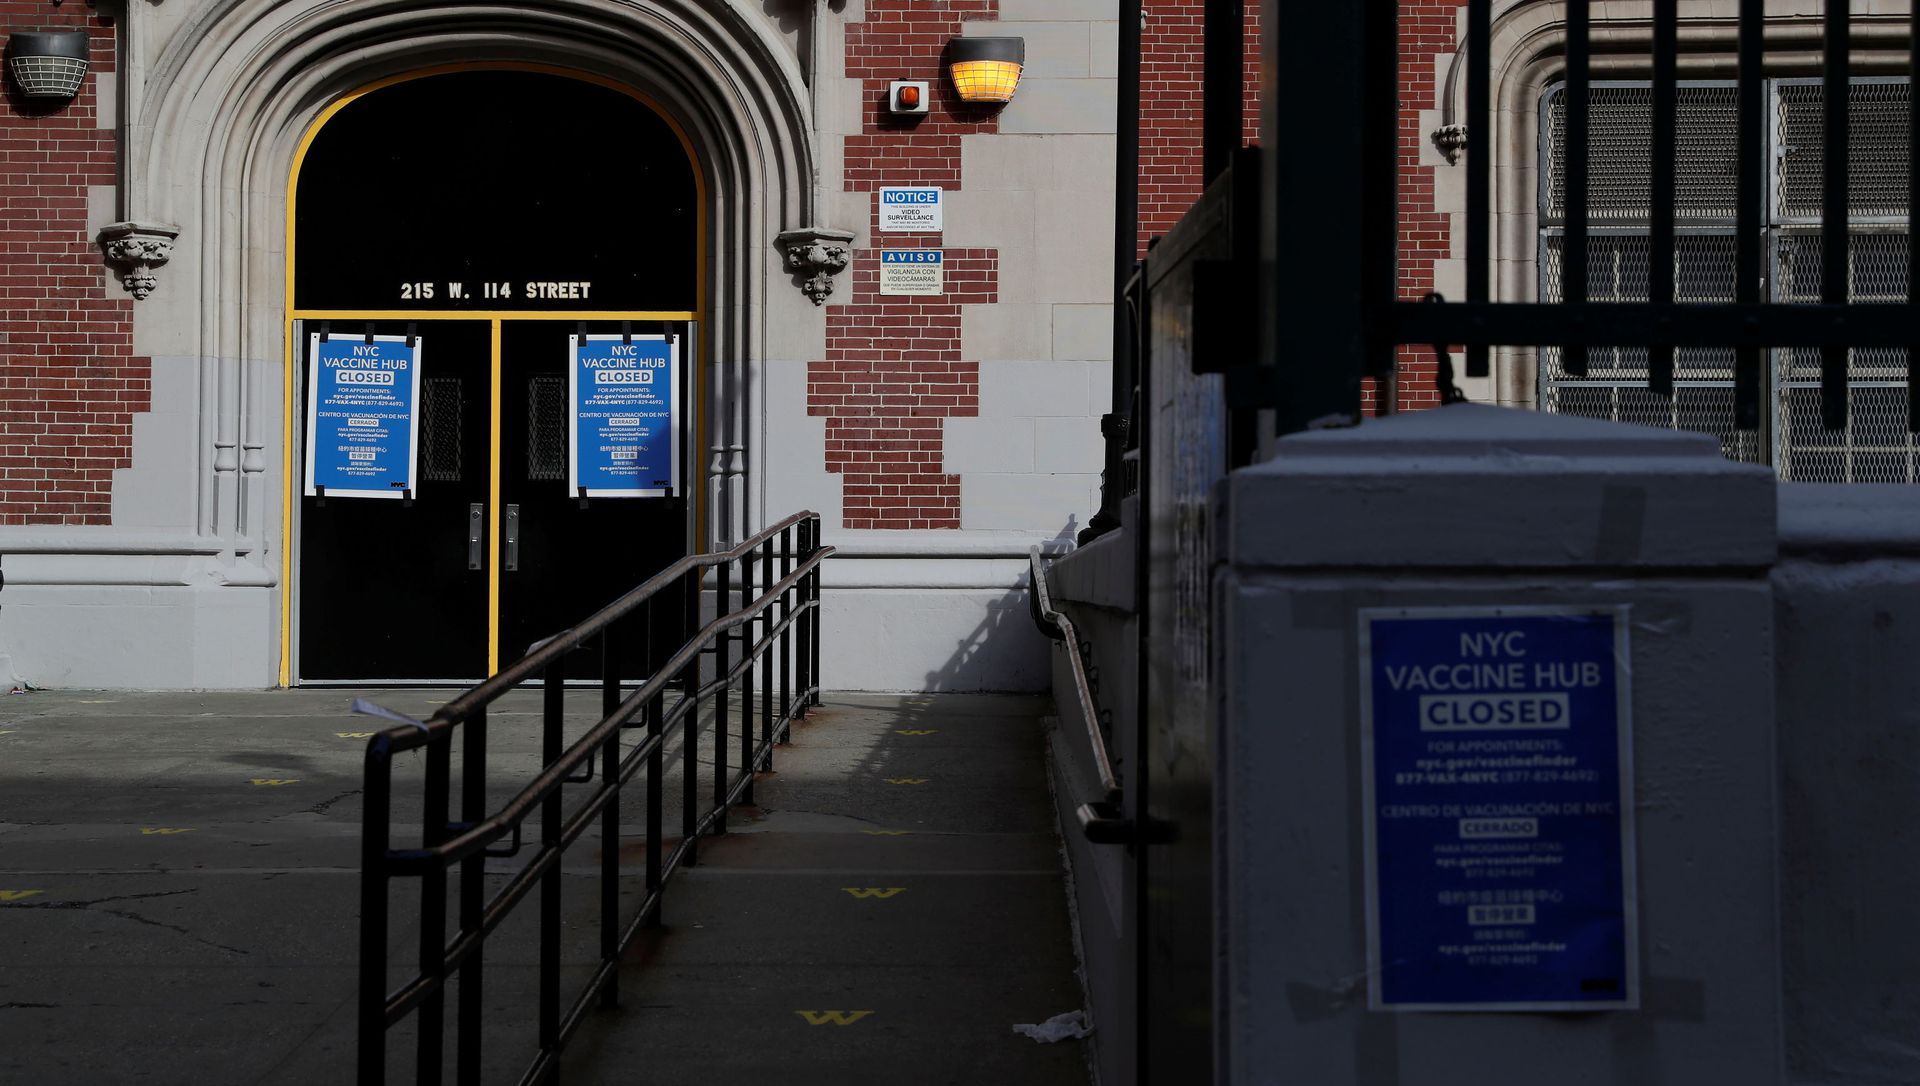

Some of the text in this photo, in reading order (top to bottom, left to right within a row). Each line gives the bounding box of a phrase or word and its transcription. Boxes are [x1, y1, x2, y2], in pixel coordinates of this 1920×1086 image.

[886, 192, 936, 202] NOTICE
[888, 253, 936, 261] AVISO
[400, 282, 434, 299] 215
[449, 282, 470, 299] W.
[526, 282, 591, 299] STREET
[354, 346, 379, 356] NYC
[612, 346, 637, 355] NYC
[324, 358, 407, 370] VACCINE HUB
[582, 358, 665, 368] VACCINE HUB
[339, 372, 392, 383] CLOSED
[598, 372, 650, 382] CLOSED
[1460, 631, 1526, 657] NYC
[1385, 662, 1600, 690] VACCINE HUB
[1427, 700, 1562, 726] CLOSED
[1428, 741, 1452, 752] FOR
[1381, 802, 1614, 818] CENTRO DE VACUNACIÓN DE NYC
[1463, 822, 1534, 834] CERRADO
